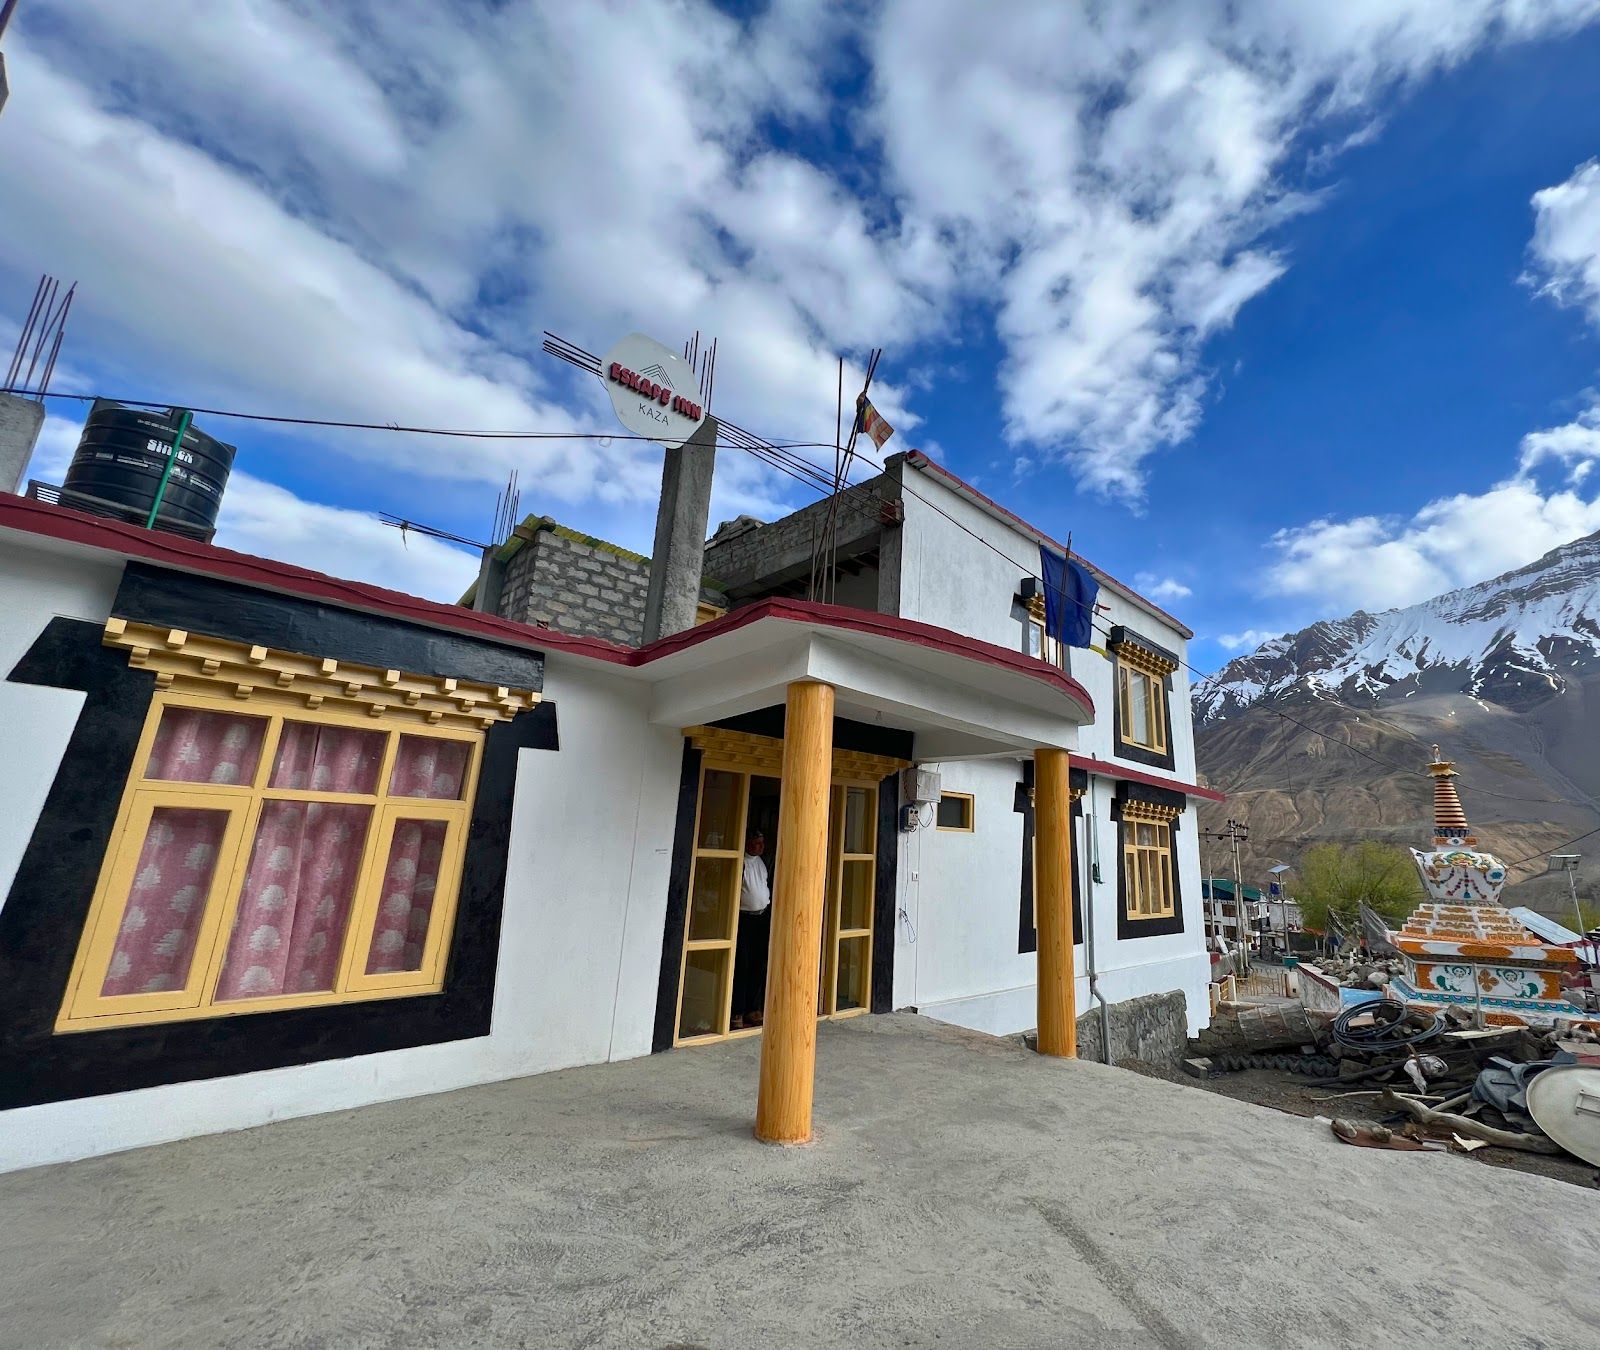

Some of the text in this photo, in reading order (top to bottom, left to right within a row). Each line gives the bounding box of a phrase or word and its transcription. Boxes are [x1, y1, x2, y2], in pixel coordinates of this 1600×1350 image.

[610, 362, 702, 421] ESKAPE INN
[638, 403, 669, 426] KAZA
[147, 439, 193, 464] Sinex
